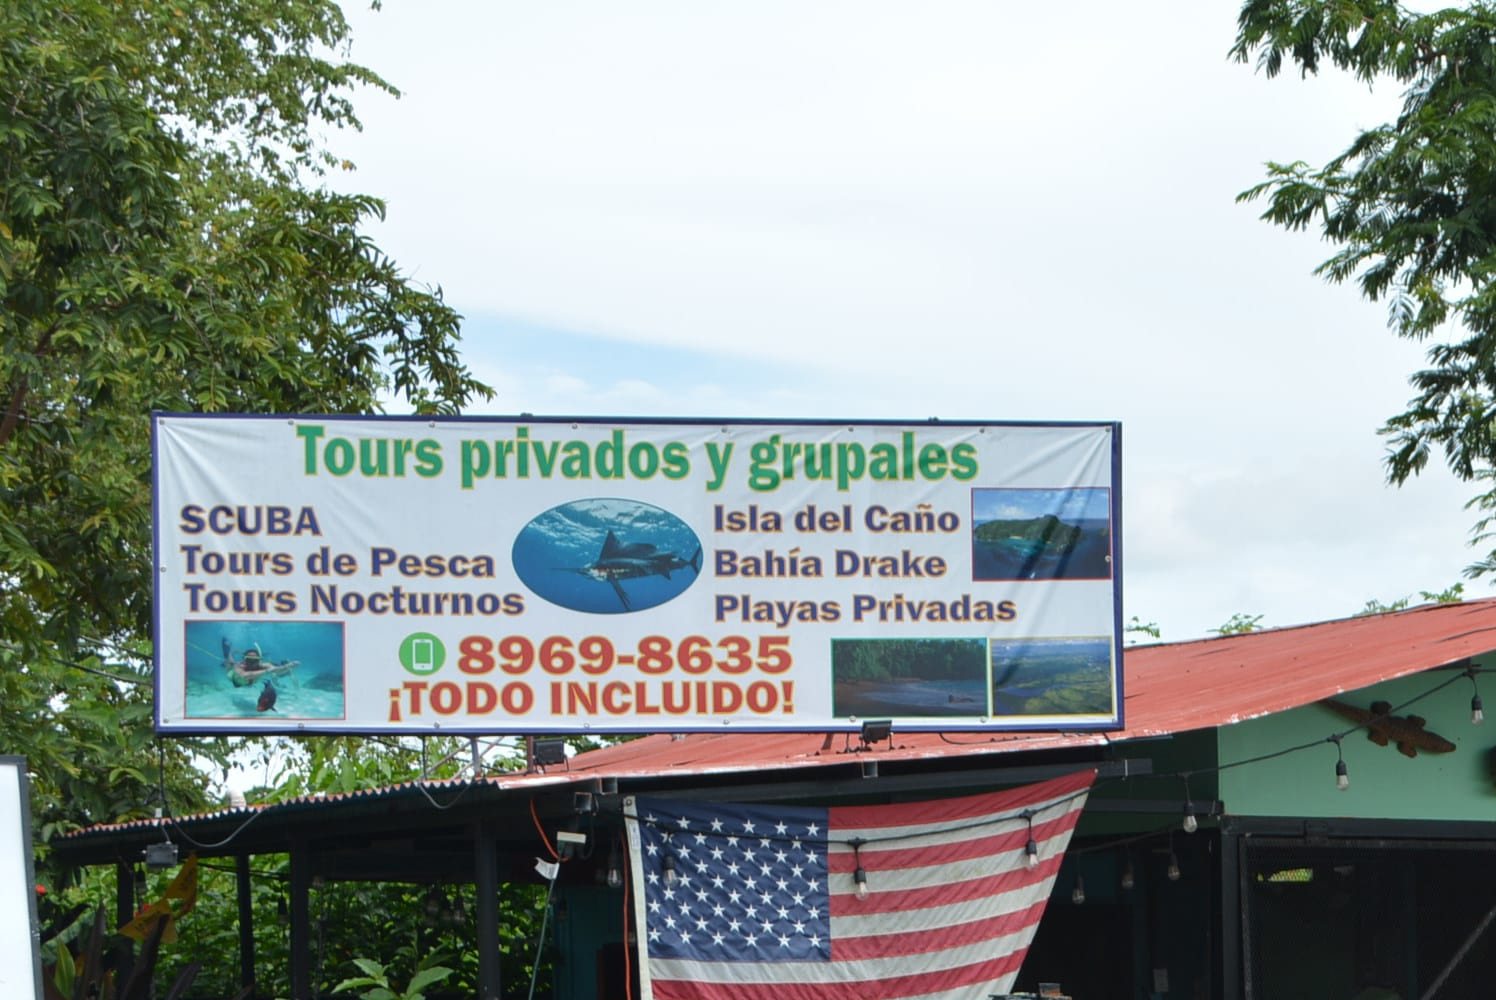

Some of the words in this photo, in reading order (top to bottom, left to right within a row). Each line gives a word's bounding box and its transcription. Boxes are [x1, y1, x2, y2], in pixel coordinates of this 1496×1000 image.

[297, 425, 443, 478] Tours
[460, 426, 691, 489] privados
[705, 441, 733, 491] y
[748, 431, 979, 492] grupales
[179, 504, 322, 537] SCUBA
[714, 504, 782, 533] Isla
[794, 505, 852, 533] del
[864, 503, 960, 534] Caño
[180, 544, 294, 575] Tours
[307, 546, 357, 577] de
[371, 547, 495, 578] Pesca
[714, 547, 823, 578] Bahía
[835, 549, 947, 578] Drake
[184, 583, 297, 614] Tours
[310, 584, 525, 616] Nocturnos
[715, 594, 841, 628] Playas
[853, 594, 1017, 624] Privadas
[457, 635, 793, 676] 8969-8635
[388, 680, 534, 722] ¡TODO
[550, 680, 795, 716] INCLUIDO!
